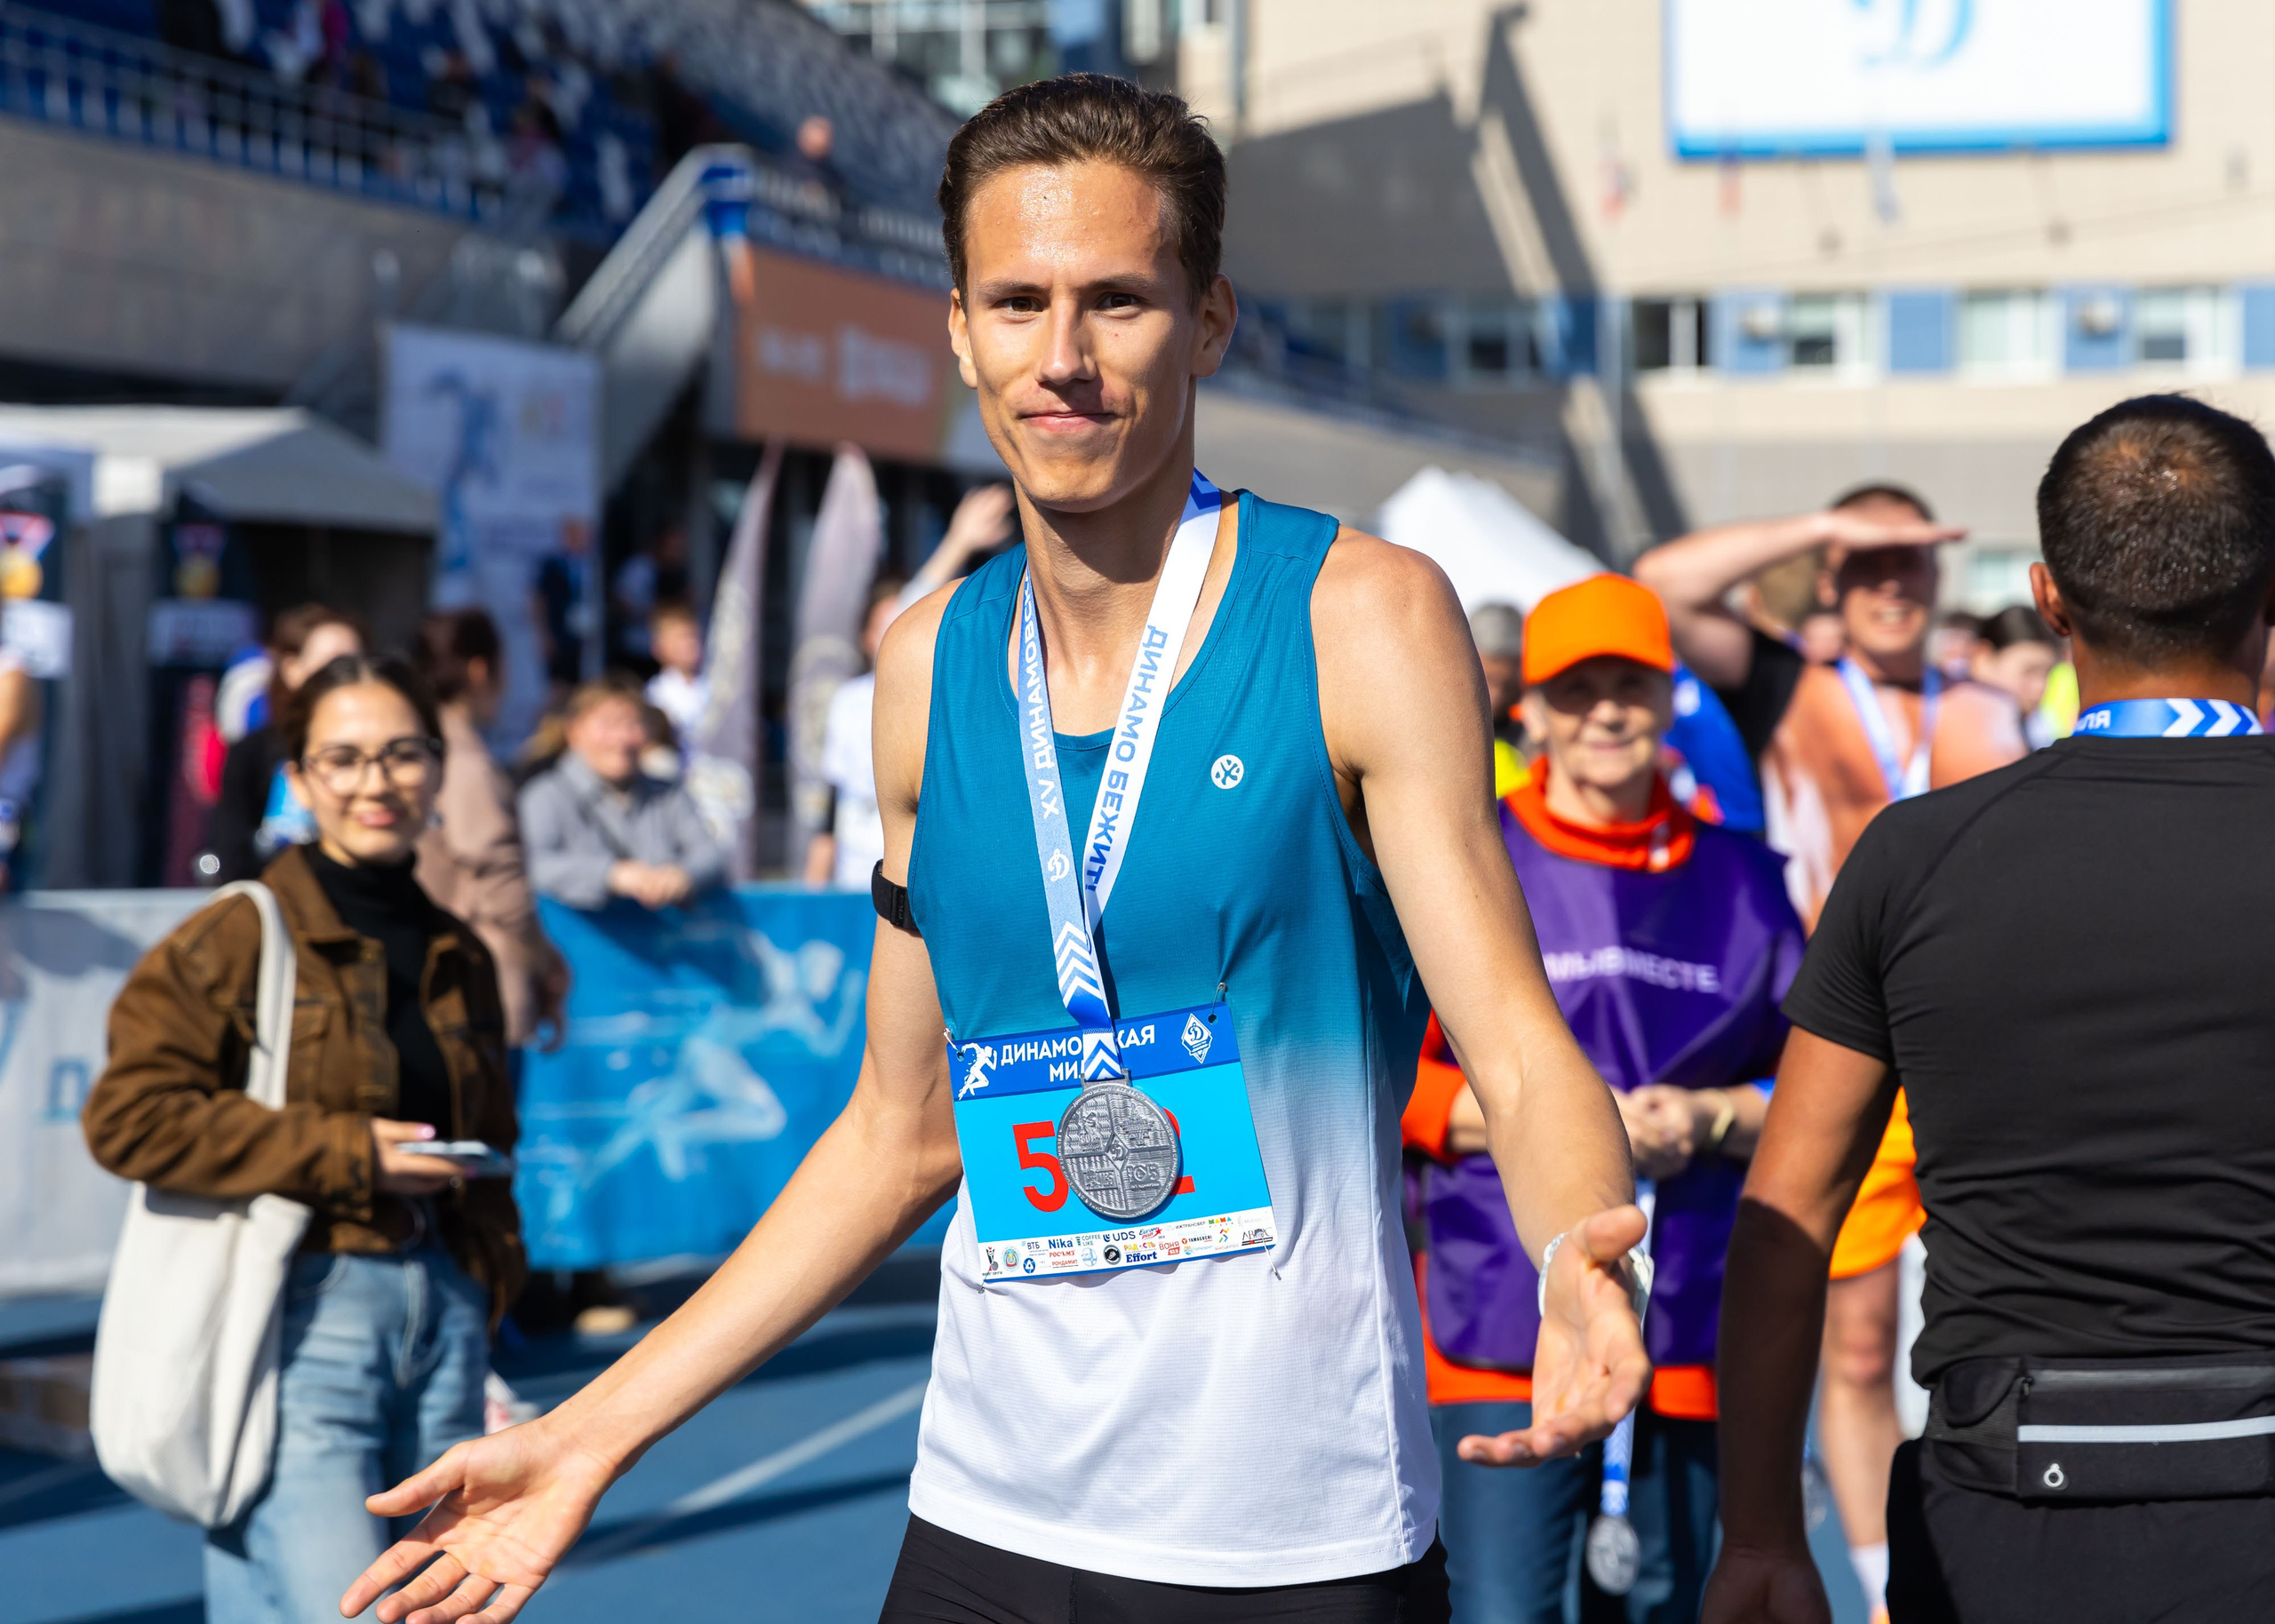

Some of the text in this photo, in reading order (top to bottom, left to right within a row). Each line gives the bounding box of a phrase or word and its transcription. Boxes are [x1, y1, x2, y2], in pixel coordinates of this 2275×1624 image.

[1084, 624, 1169, 892] ДИНАМО БЕЖИТ!
[1001, 1024, 1155, 1066] ДИНАМОКАЯ
[1113, 1230, 1136, 1241] UDS
[1026, 1241, 1041, 1250] ВТБ
[1048, 1238, 1074, 1249] Nika
[1126, 1251, 1158, 1262] Effort
